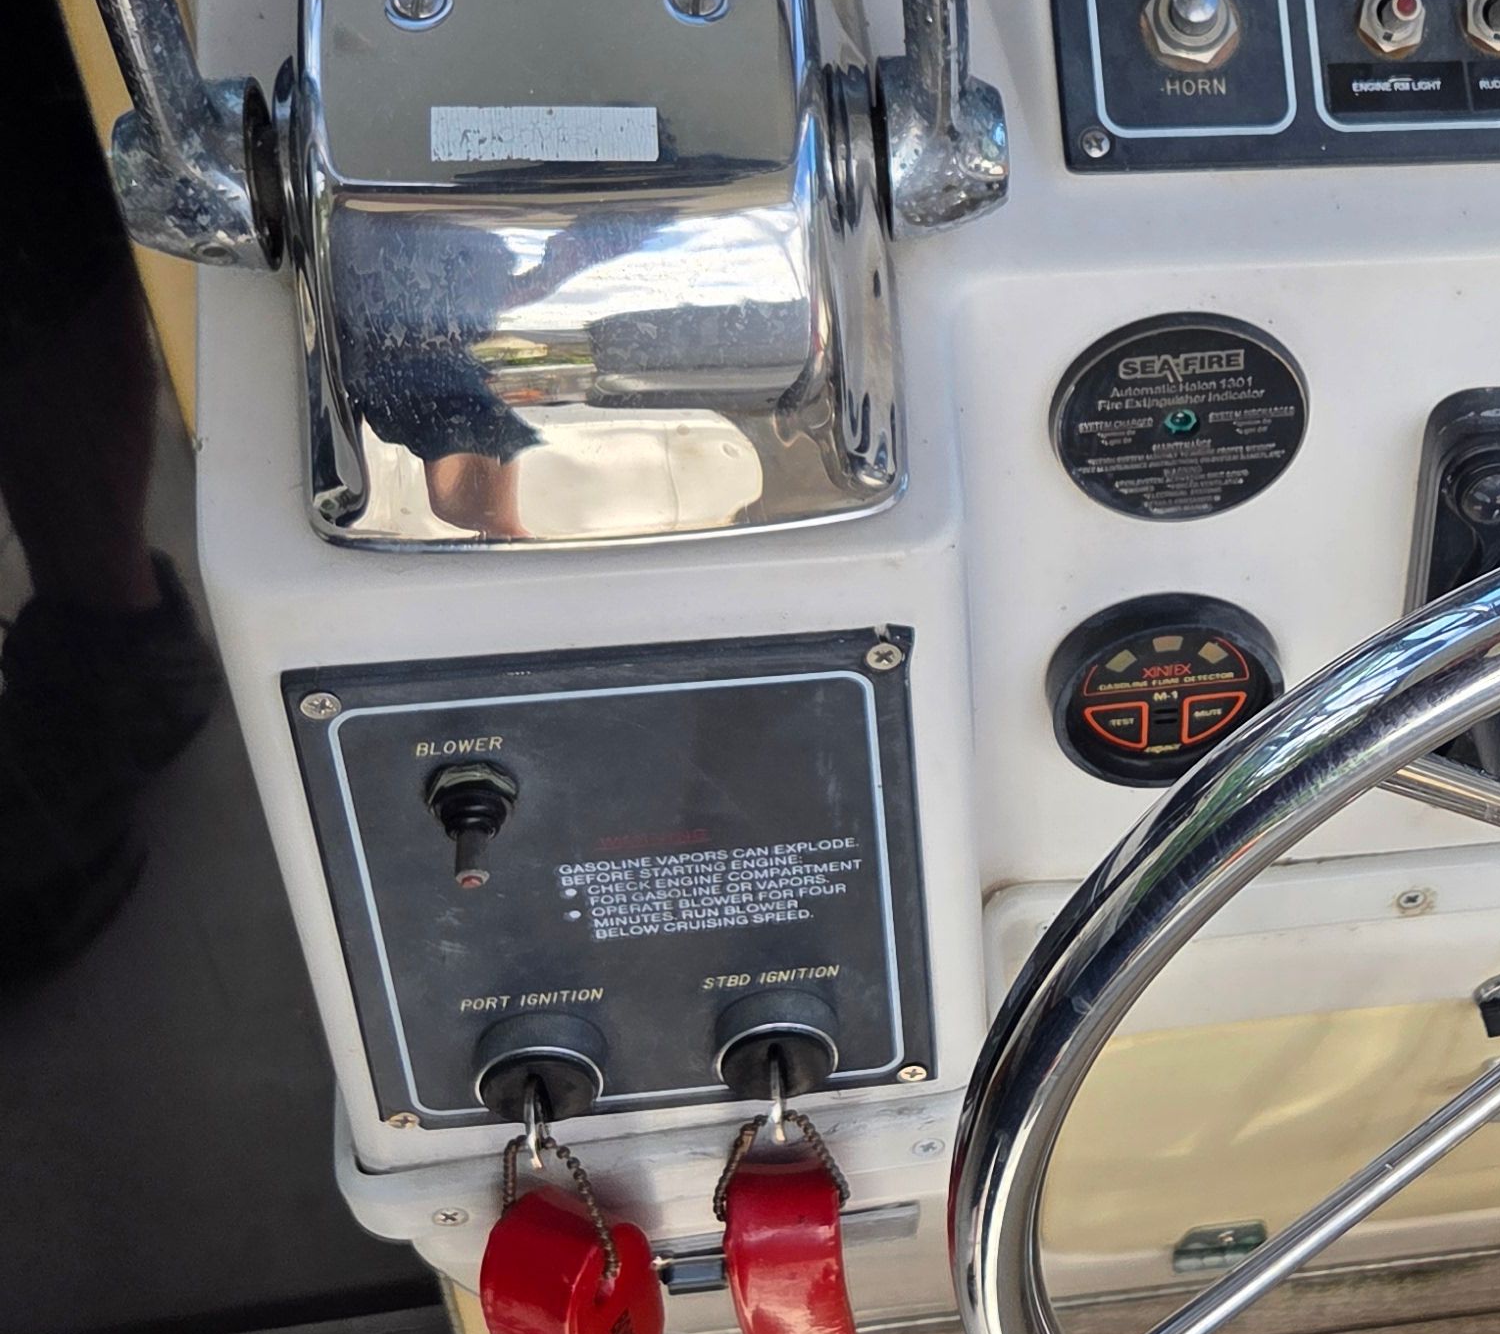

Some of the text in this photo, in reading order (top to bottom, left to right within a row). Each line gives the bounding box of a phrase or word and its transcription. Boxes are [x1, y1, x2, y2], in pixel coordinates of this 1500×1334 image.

[1166, 77, 1227, 96] HORN
[1352, 80, 1392, 92] ENGINE
[1411, 79, 1442, 91] LIGHT
[1098, 388, 1266, 412] Fire Extinguisher Indicator
[1110, 383, 1177, 398] Automatic
[1099, 680, 1149, 691] GASOLINE
[1183, 671, 1235, 683] DETECTOR
[1142, 663, 1192, 679] XINTEX
[1153, 690, 1179, 702] M-1
[1110, 717, 1135, 727] TEST
[416, 736, 504, 757] BLOWER
[559, 837, 860, 875] GASOLINE VAPORS CAN EXPLODE.
[561, 854, 803, 887] BEFORE STARTING ENGINE:
[587, 859, 863, 896] CHECK ENGINE COMPARTMENT
[590, 874, 831, 907] FOR GASOLINE OR VAPORS.
[592, 883, 847, 918] OPERATE BLOWER FOR FOUR
[594, 900, 799, 929] MINUTES. RUN BLOWER
[595, 909, 815, 940] BELOW CRUISING SPEED.
[702, 964, 841, 990] STBD IGNITION
[460, 987, 604, 1013] PORT IGNITION
